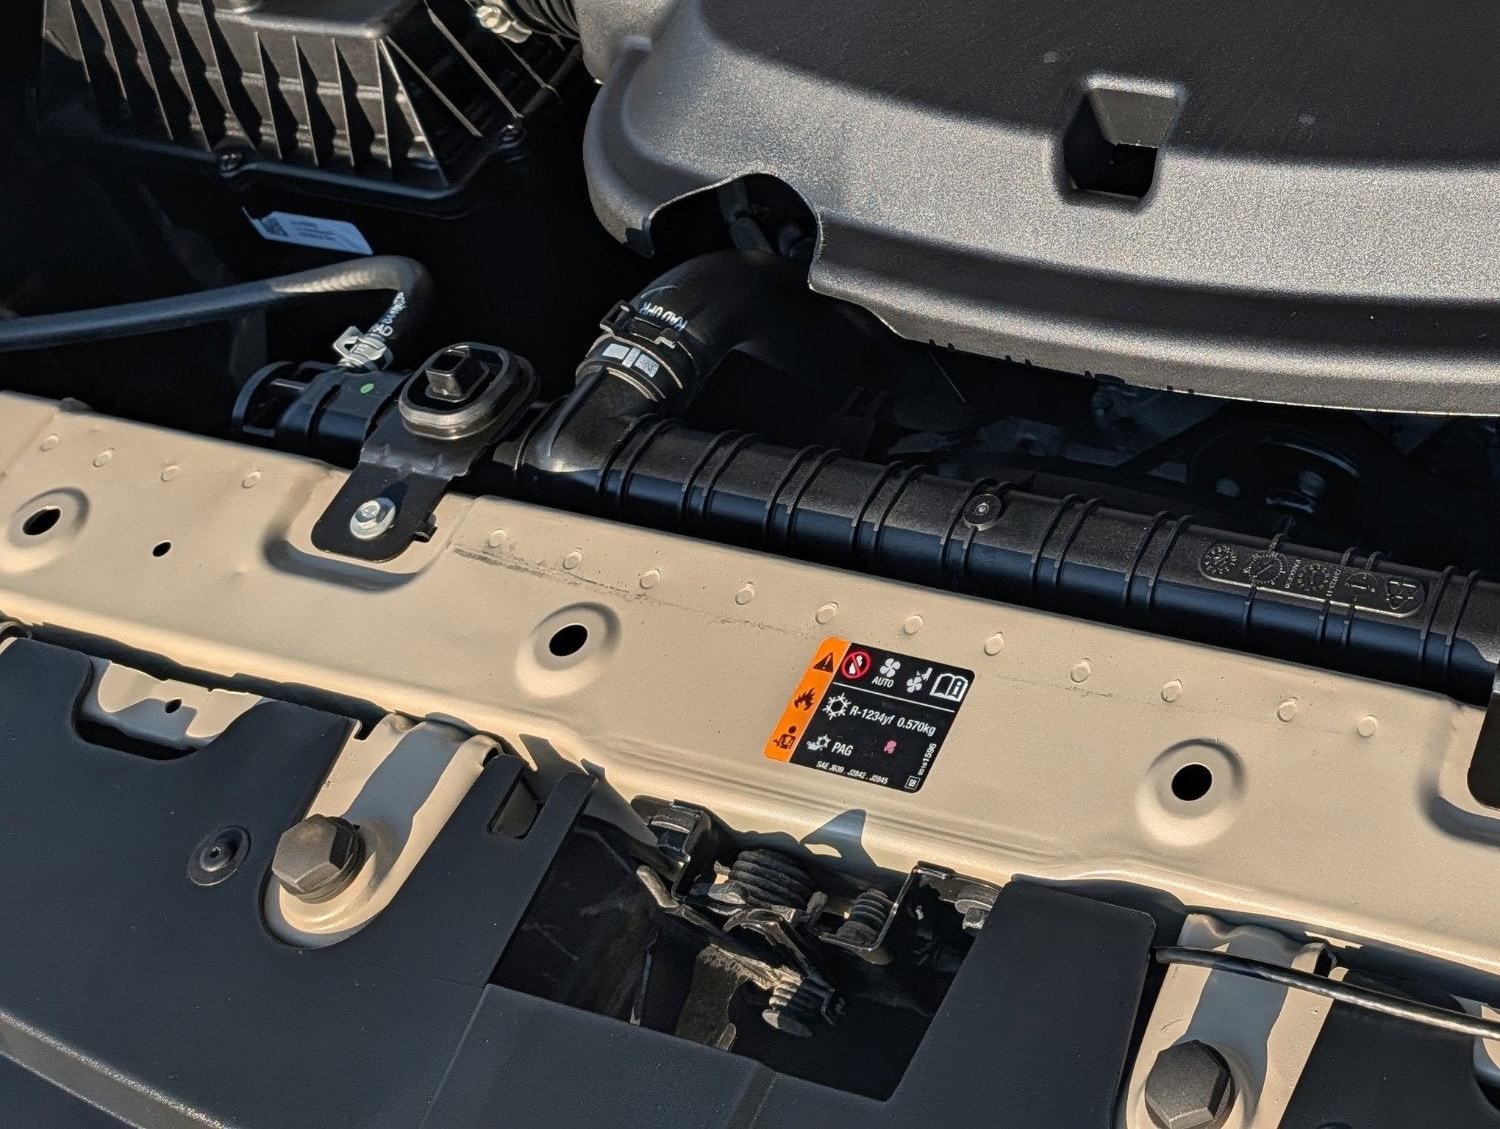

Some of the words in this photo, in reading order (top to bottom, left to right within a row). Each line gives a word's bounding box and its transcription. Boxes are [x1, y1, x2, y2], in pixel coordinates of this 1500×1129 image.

[871, 676, 894, 688] AUTO
[849, 706, 895, 726] R-1234yf
[896, 716, 937, 737] 0.570kg
[831, 742, 854, 757] PAG
[816, 760, 830, 770] SAE
